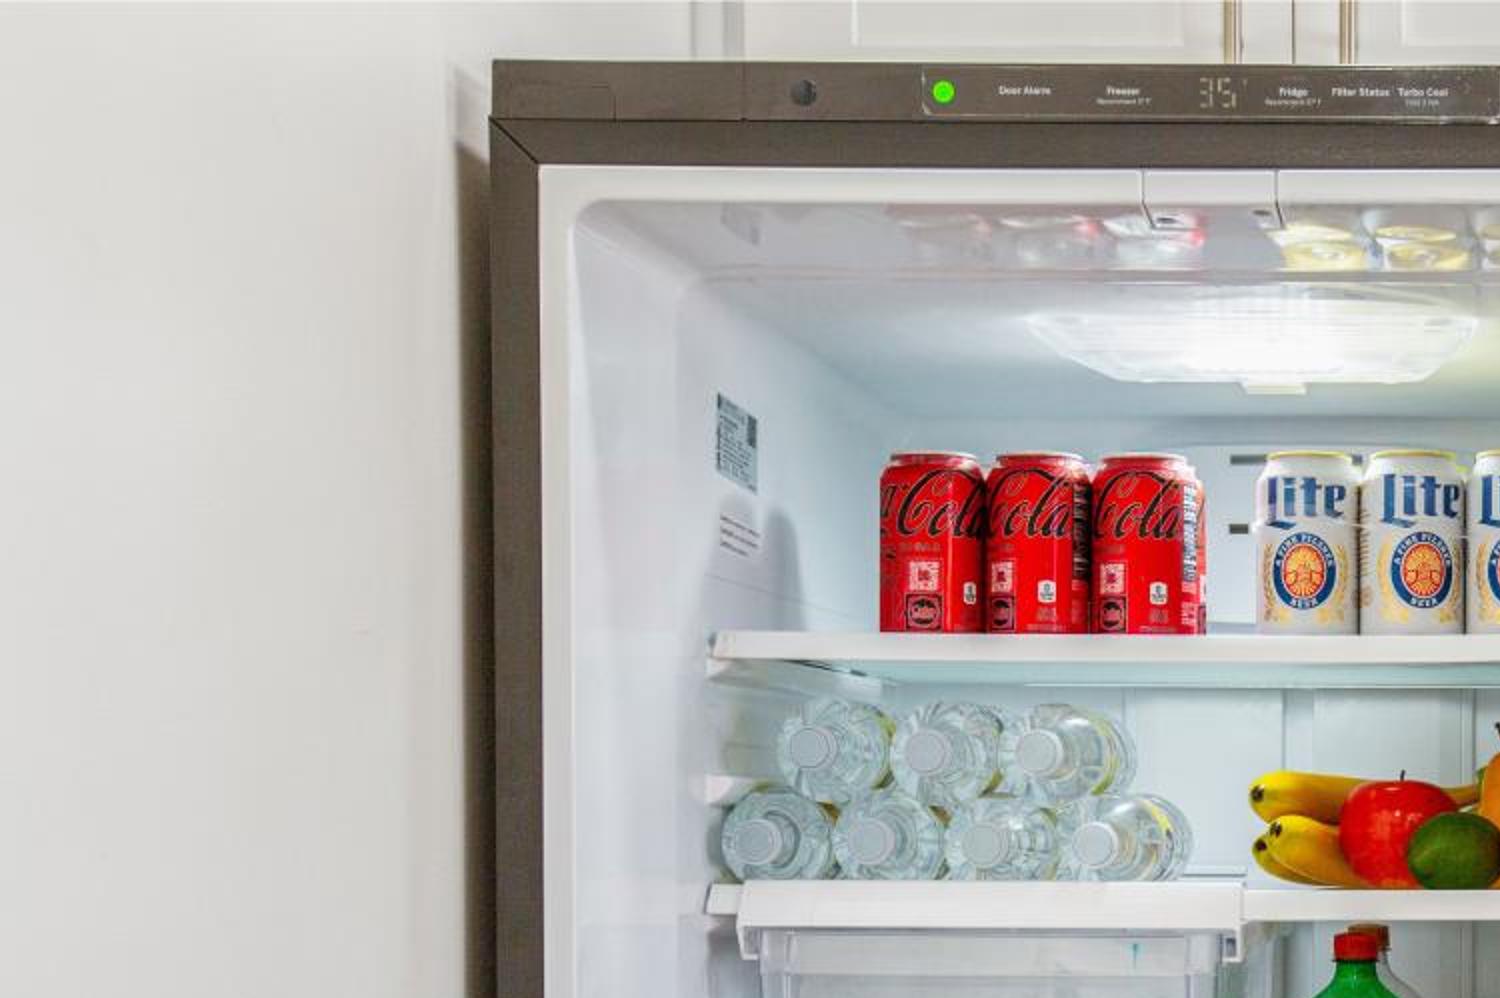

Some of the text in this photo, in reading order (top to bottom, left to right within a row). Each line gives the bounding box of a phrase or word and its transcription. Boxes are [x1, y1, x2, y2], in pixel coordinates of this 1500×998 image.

[999, 86, 1052, 96] Door Alarm
[1106, 86, 1140, 96] Freezer
[1279, 87, 1309, 99] Fridge
[1332, 87, 1390, 97] Filter Status
[1397, 87, 1449, 97] Turbo Cool
[1265, 477, 1346, 530] Lite
[1380, 474, 1459, 528] Lite
